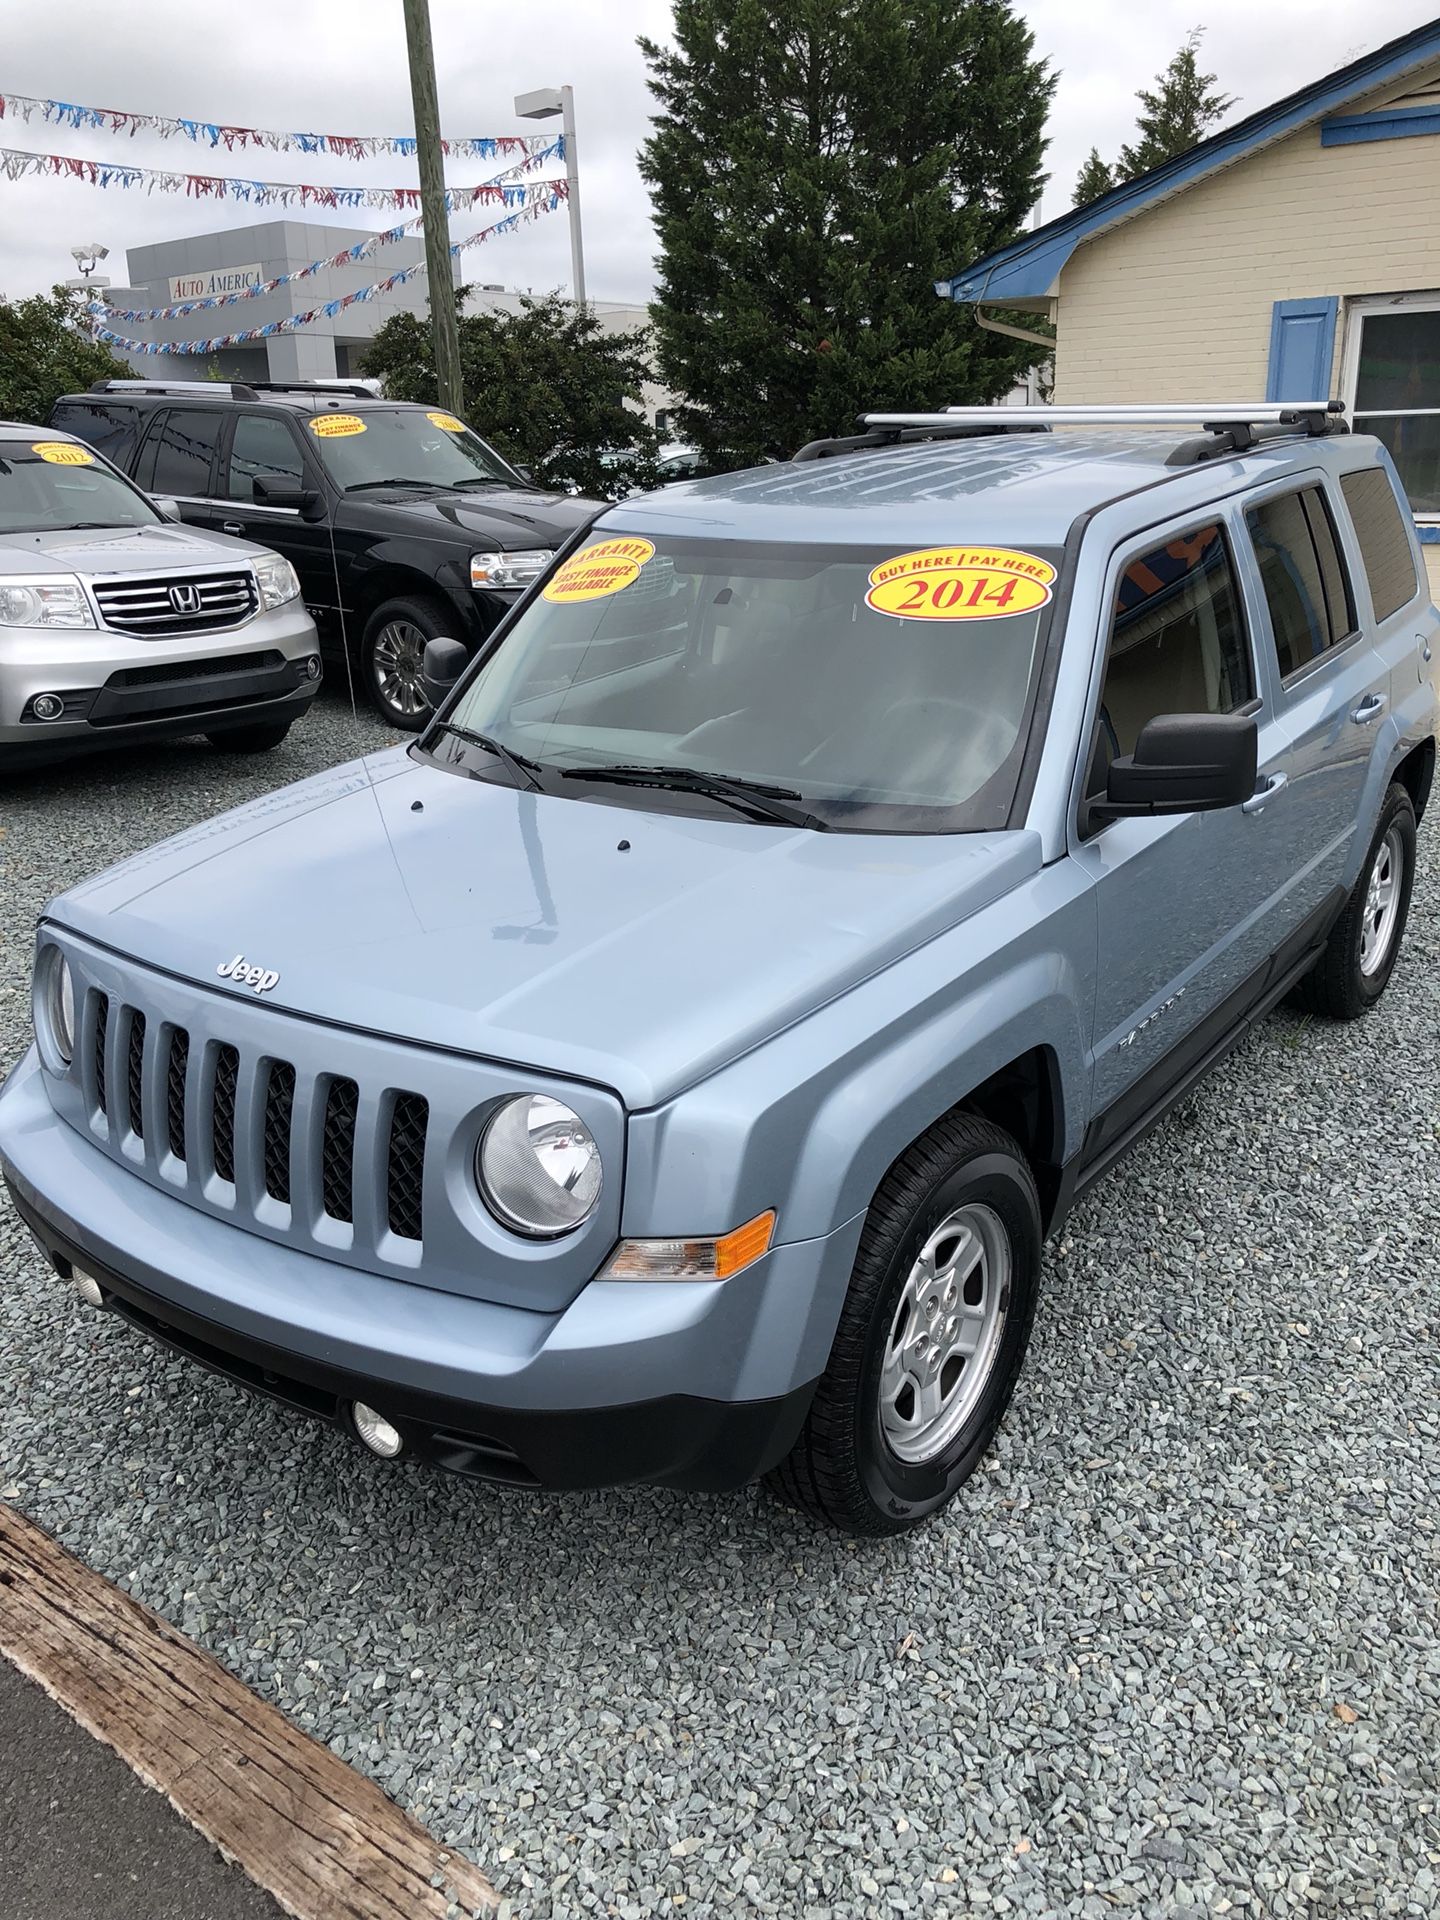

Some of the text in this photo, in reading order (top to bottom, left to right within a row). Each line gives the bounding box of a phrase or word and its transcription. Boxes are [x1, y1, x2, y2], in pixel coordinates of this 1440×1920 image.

[173, 272, 260, 298] AUTO AMERICA
[50, 453, 88, 462] 2012
[561, 543, 650, 571] WARRANTY
[878, 564, 908, 582] BUY
[912, 555, 954, 570] HERE
[969, 555, 1001, 565] PAY
[1003, 559, 1047, 578] HERE
[552, 578, 617, 594] AVAILABLE
[553, 565, 636, 584] EASY FINANCE
[896, 578, 1019, 610] 2014
[216, 954, 280, 995] Jeep
